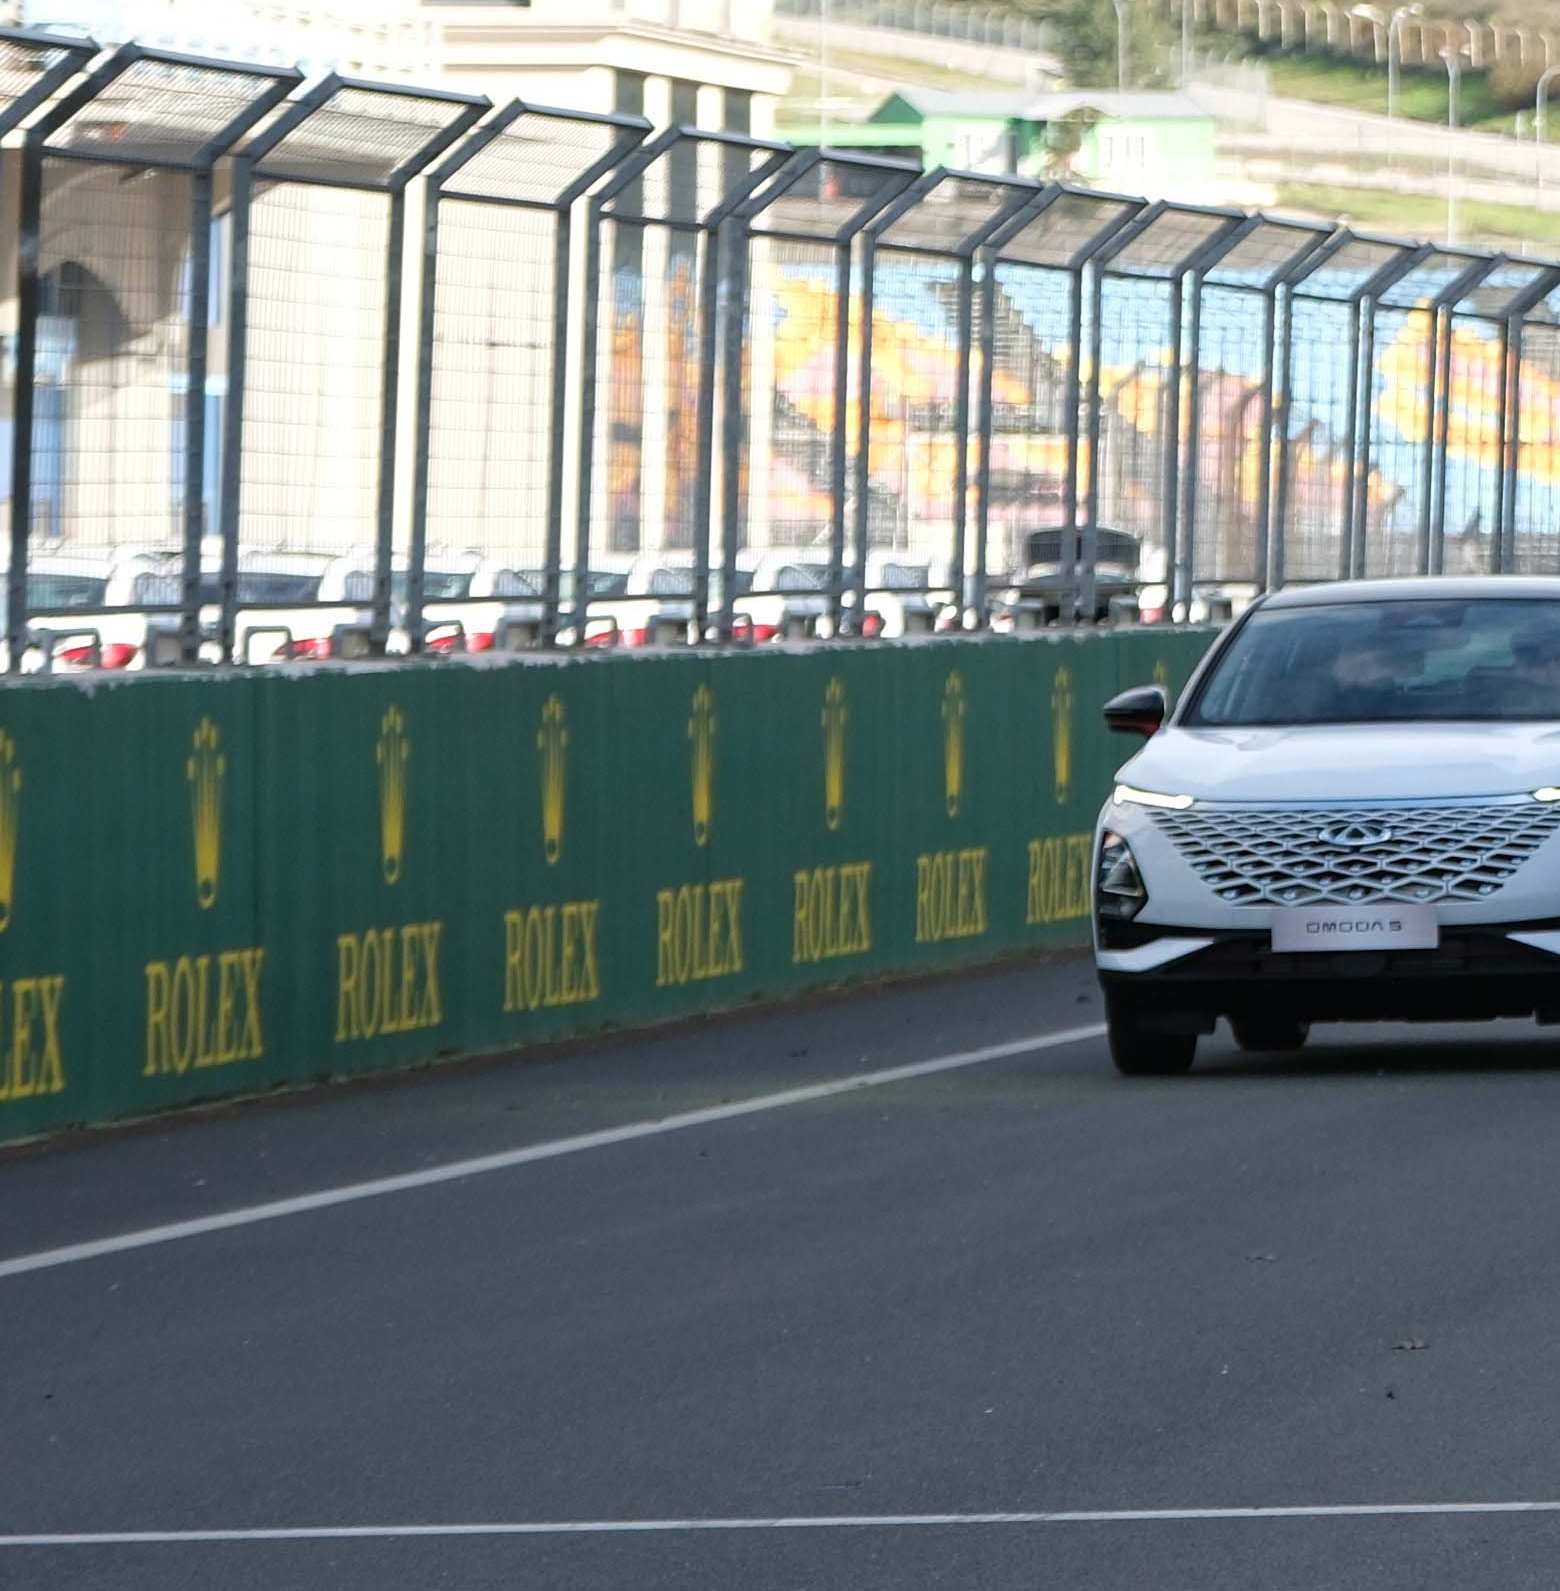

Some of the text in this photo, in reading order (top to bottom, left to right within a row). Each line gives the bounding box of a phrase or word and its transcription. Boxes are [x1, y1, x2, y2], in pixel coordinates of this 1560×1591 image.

[793, 862, 871, 963] ROLEX
[916, 846, 988, 943] ROLEX
[1028, 833, 1092, 924] ROLEX
[335, 922, 442, 1042] ROLEX
[503, 900, 600, 1011] ROLEX
[656, 879, 744, 986] ROLEX
[143, 947, 265, 1076] ROLEX
